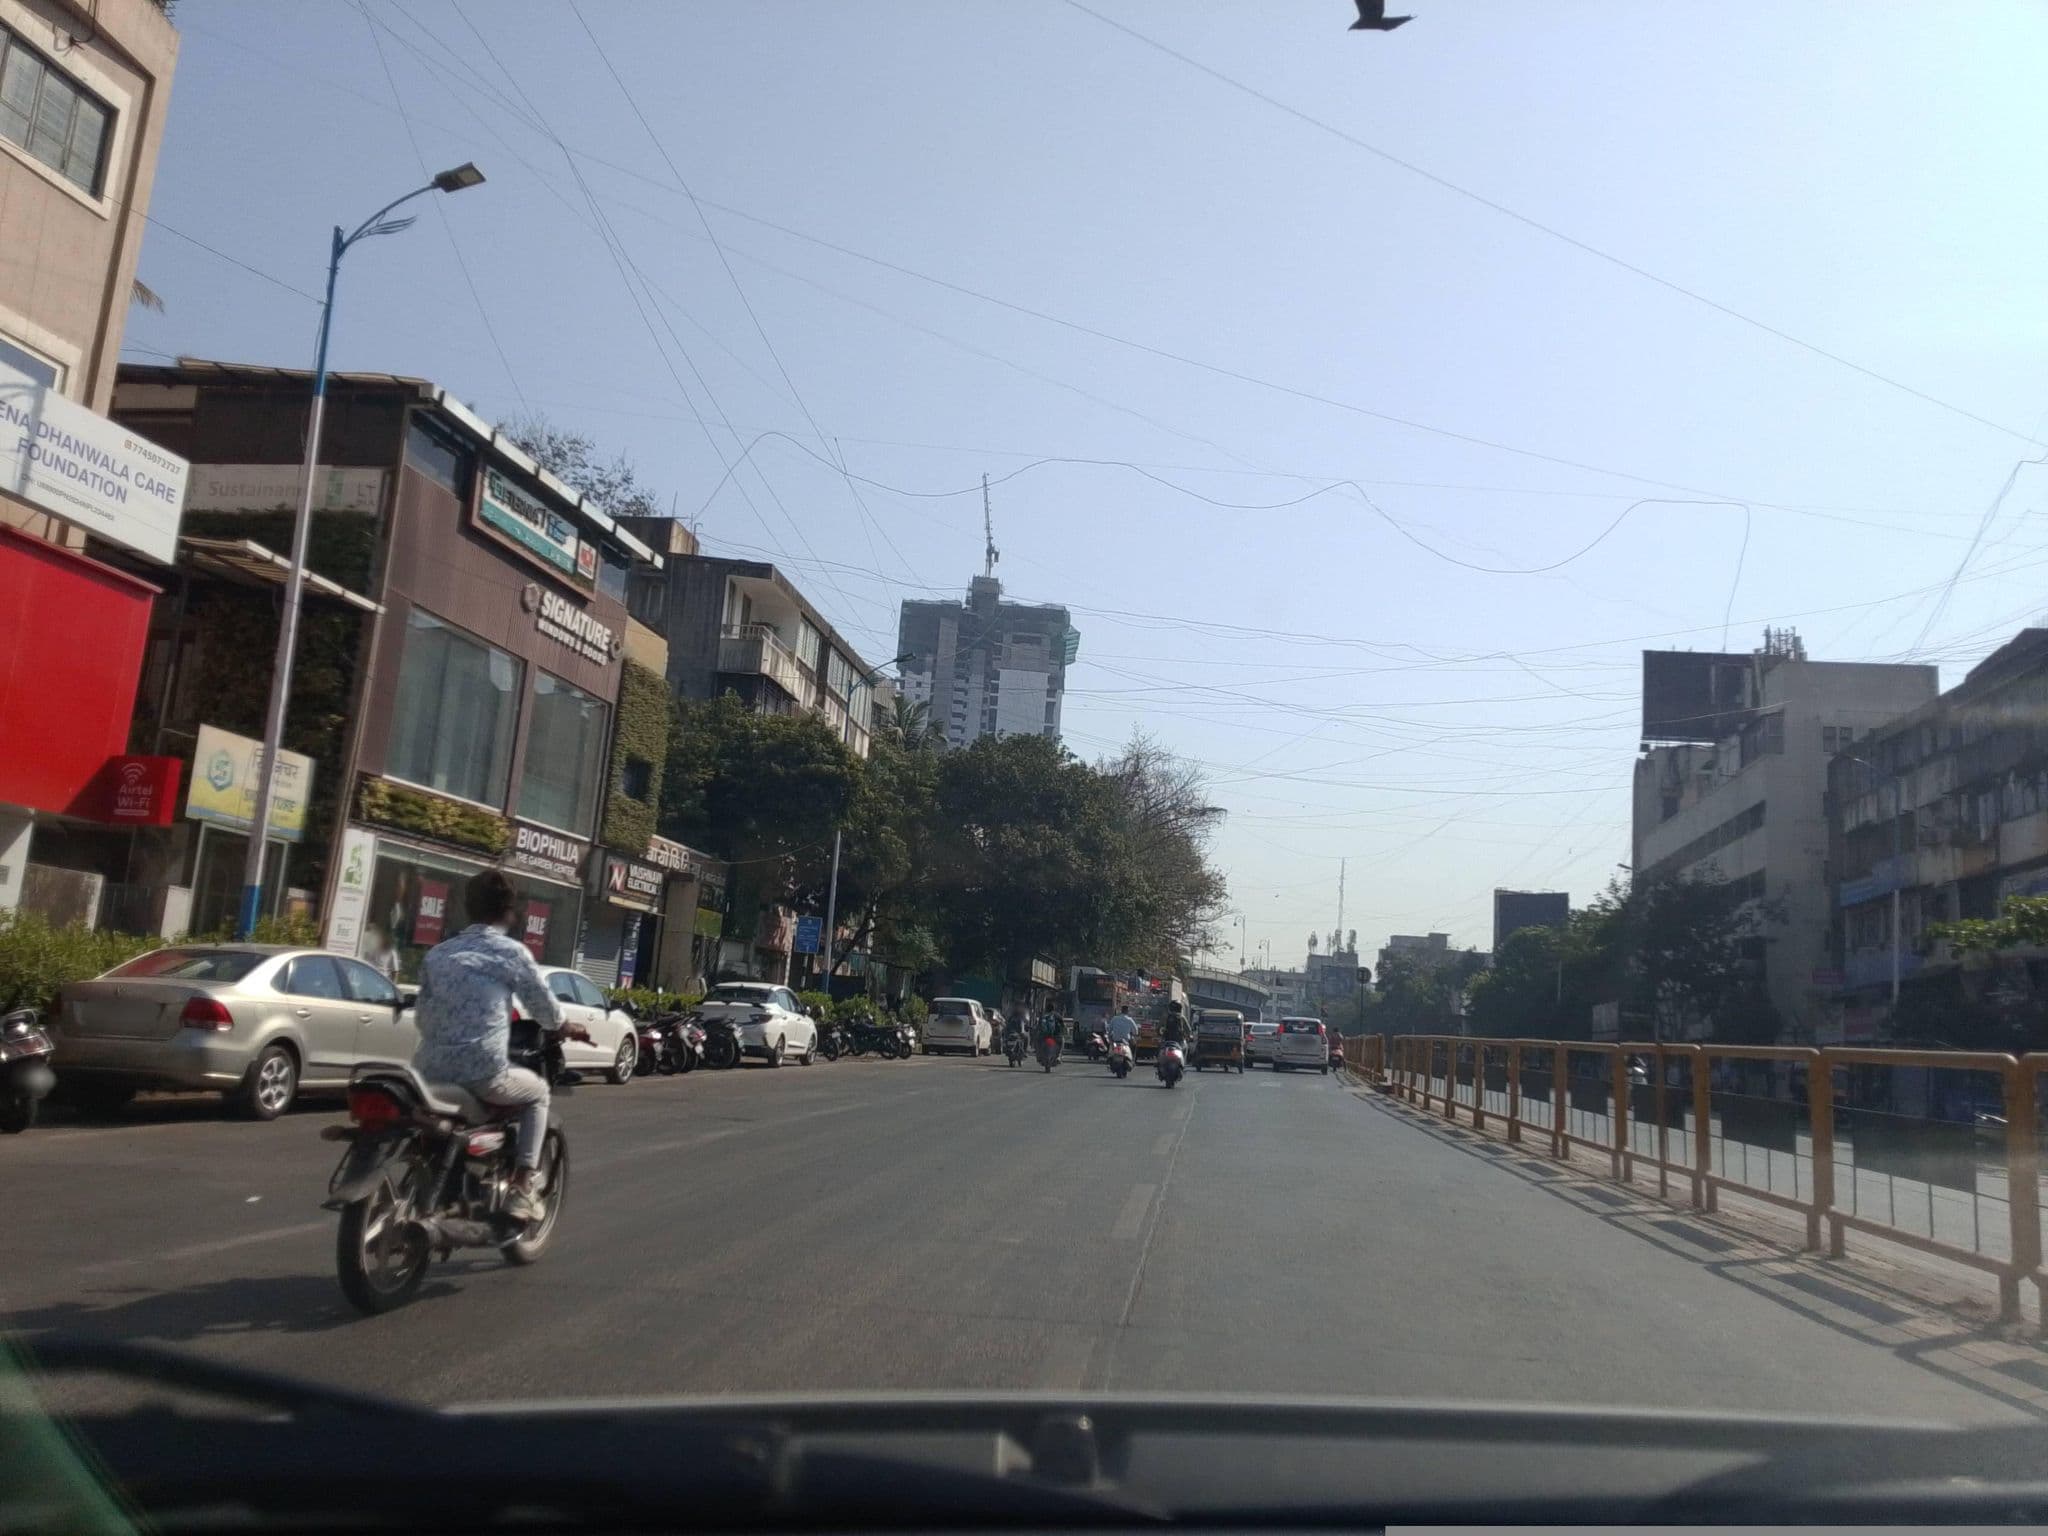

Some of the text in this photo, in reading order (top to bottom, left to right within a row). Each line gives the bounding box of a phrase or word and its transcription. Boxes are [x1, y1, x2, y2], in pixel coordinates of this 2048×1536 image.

[17, 436, 128, 504] FOUNDATION
[36, 421, 130, 482] DHANWALA
[134, 470, 177, 504] CARE
[541, 591, 612, 652] SIGNATURE
[537, 618, 576, 648] WINDOWS
[582, 643, 609, 667] DOORS
[117, 797, 151, 808] Wi-Fi
[119, 784, 153, 796] Airtel
[516, 827, 579, 864] BIOPHILIA
[515, 852, 529, 864] THE
[528, 855, 553, 870] GARDEN
[420, 895, 445, 919] SALE
[526, 917, 547, 936] SALE
